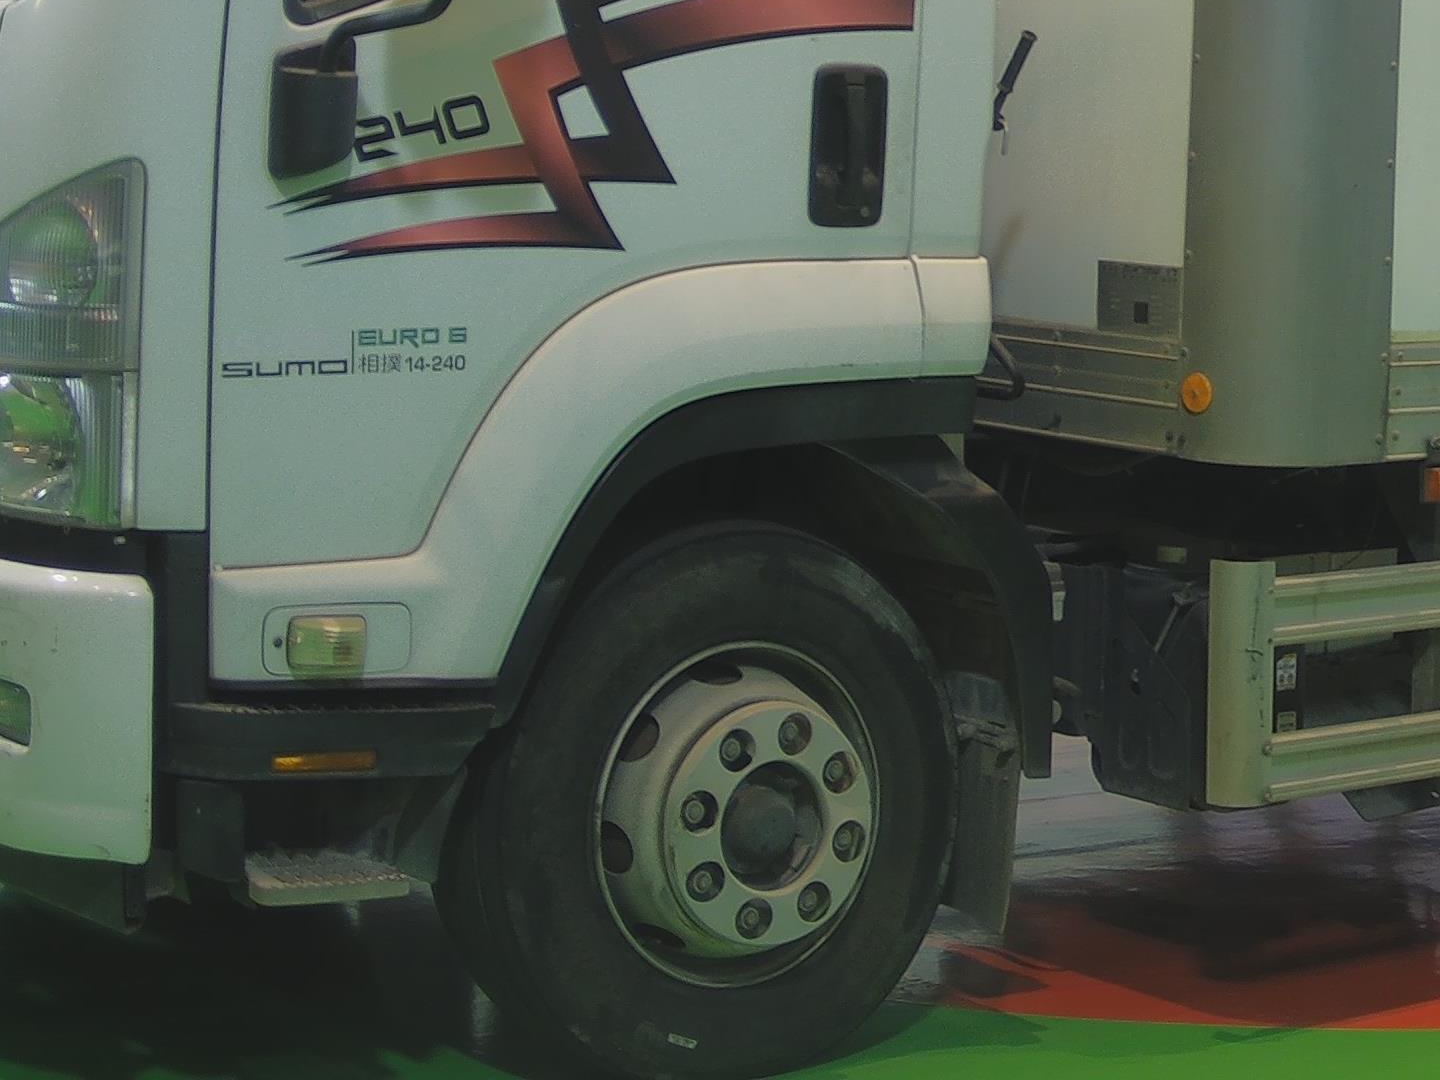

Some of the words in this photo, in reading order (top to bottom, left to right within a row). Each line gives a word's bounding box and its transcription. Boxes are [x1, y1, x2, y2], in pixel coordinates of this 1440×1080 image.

[353, 94, 491, 163] 240
[358, 327, 440, 348] EURO
[404, 354, 466, 373] 14-240
